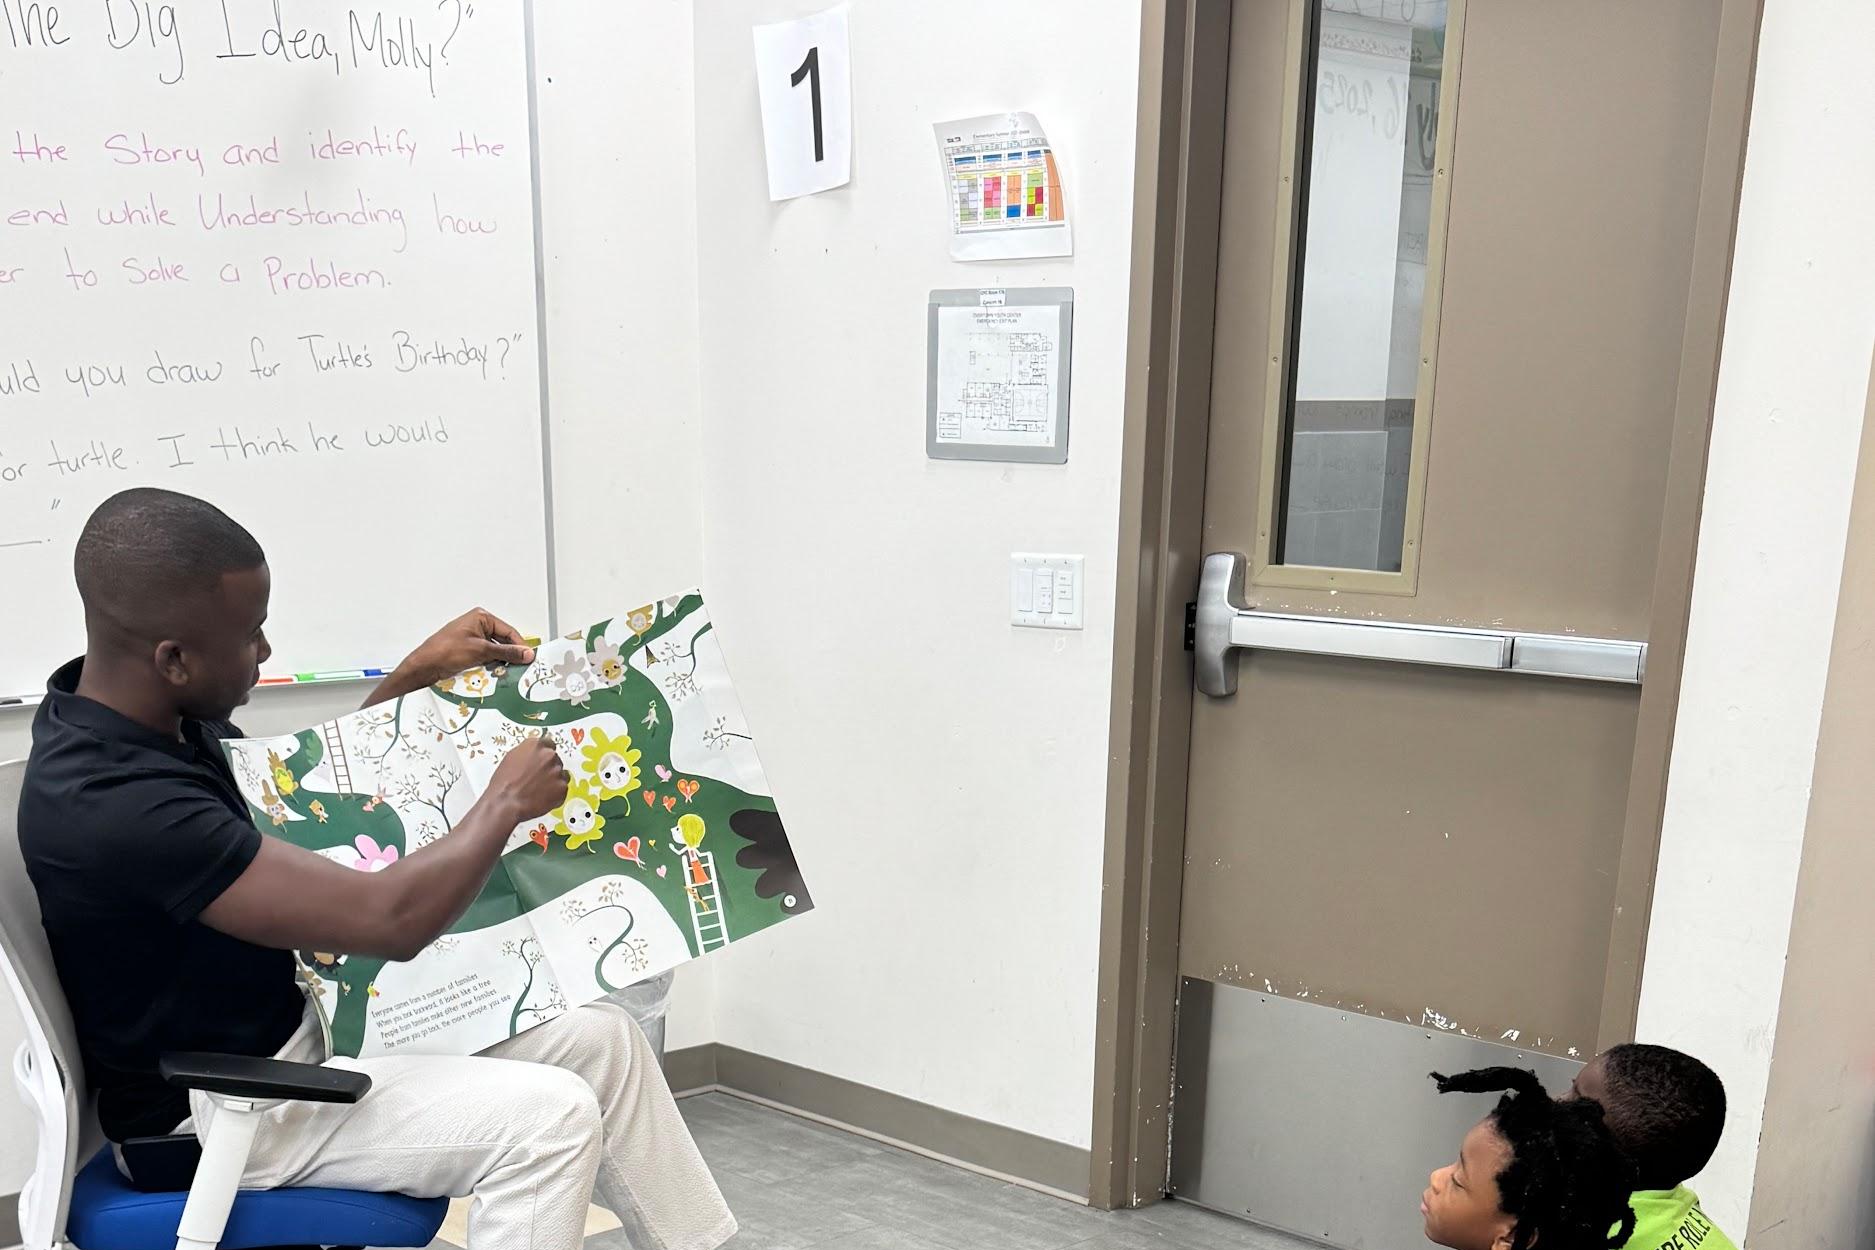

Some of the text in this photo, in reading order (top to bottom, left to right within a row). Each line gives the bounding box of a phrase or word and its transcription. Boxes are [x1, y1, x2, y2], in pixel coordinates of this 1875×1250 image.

[791, 47, 823, 162] 1
[12, 126, 504, 176] the Story and identify the
[8, 189, 496, 253] end while Understanding how
[64, 247, 97, 290] to
[220, 264, 240, 282] a
[264, 256, 391, 295] Problem.
[66, 365, 126, 397] you
[147, 350, 222, 384] draw
[250, 336, 280, 379] for
[297, 334, 372, 372] Turtle's
[0, 451, 27, 481] or
[157, 433, 194, 468] I
[210, 427, 298, 460] think
[308, 422, 344, 452] he
[365, 416, 448, 447] would
[1679, 1211, 1711, 1250] ROLE
